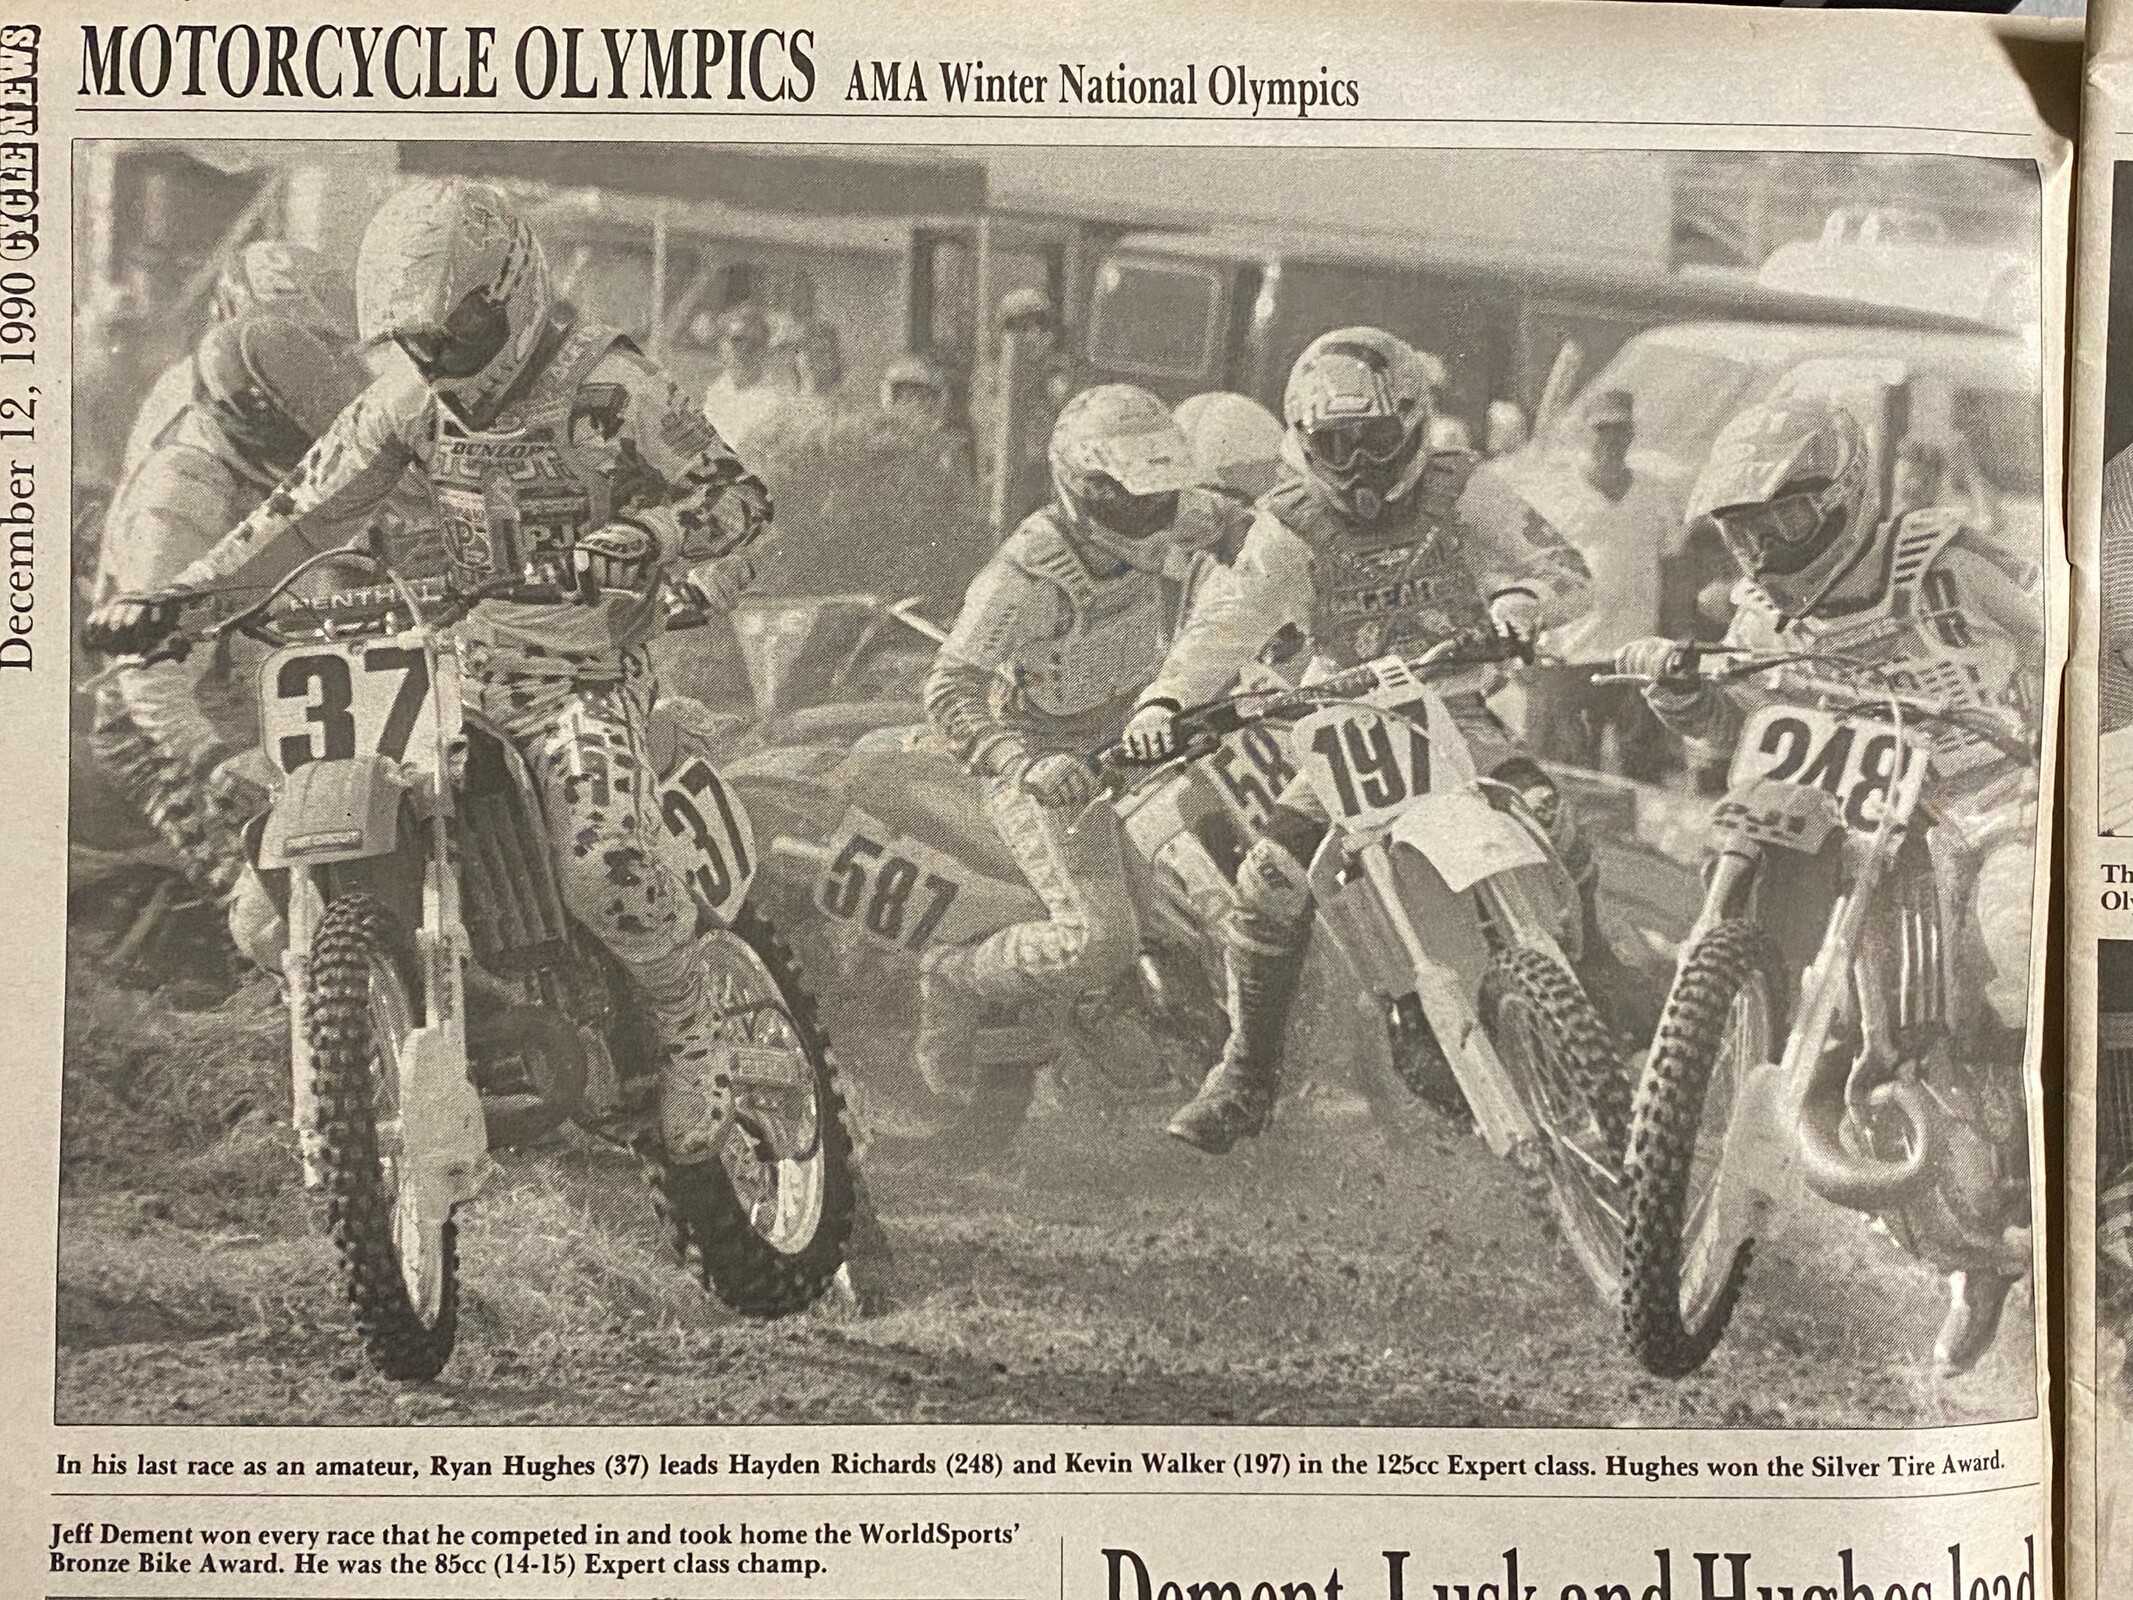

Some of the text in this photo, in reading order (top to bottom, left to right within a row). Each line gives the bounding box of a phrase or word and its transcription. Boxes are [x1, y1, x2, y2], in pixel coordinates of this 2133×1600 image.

[78, 24, 816, 103] MOTORCYCLE OLYMPICS
[844, 60, 1360, 117] AMA Winter National Olympics
[0, 24, 42, 673] December 12, 1990 CYCLE NEWS
[290, 582, 444, 612] ENTHL
[277, 647, 432, 775] 37
[1311, 699, 1432, 818] 197
[1758, 716, 1913, 834] 248
[662, 760, 751, 908] 37
[823, 834, 960, 949] 587
[2100, 890, 2133, 915] Ol
[56, 1449, 2006, 1484] In his last race as an amateur, Ryan Hughes (37) leads Hayden Richards (248) and Kevin Walker (197) in the 125cc Expert class. Hughes won the Silver Tire Award.
[48, 1523, 96, 1551] Jeff
[100, 1523, 195, 1546] Dement
[199, 1530, 253, 1546] won
[258, 1530, 322, 1552] every
[327, 1531, 377, 1547] race
[383, 1524, 432, 1547] that
[437, 1524, 467, 1547] he
[471, 1524, 589, 1552] competed
[595, 1523, 622, 1546] in
[627, 1523, 673, 1546] and
[680, 1523, 734, 1546] took
[740, 1523, 809, 1546] home
[815, 1523, 853, 1546] the
[49, 1552, 829, 1581] Bronze Bike Award. He was the 85cc (14-15) Expert class champ.
